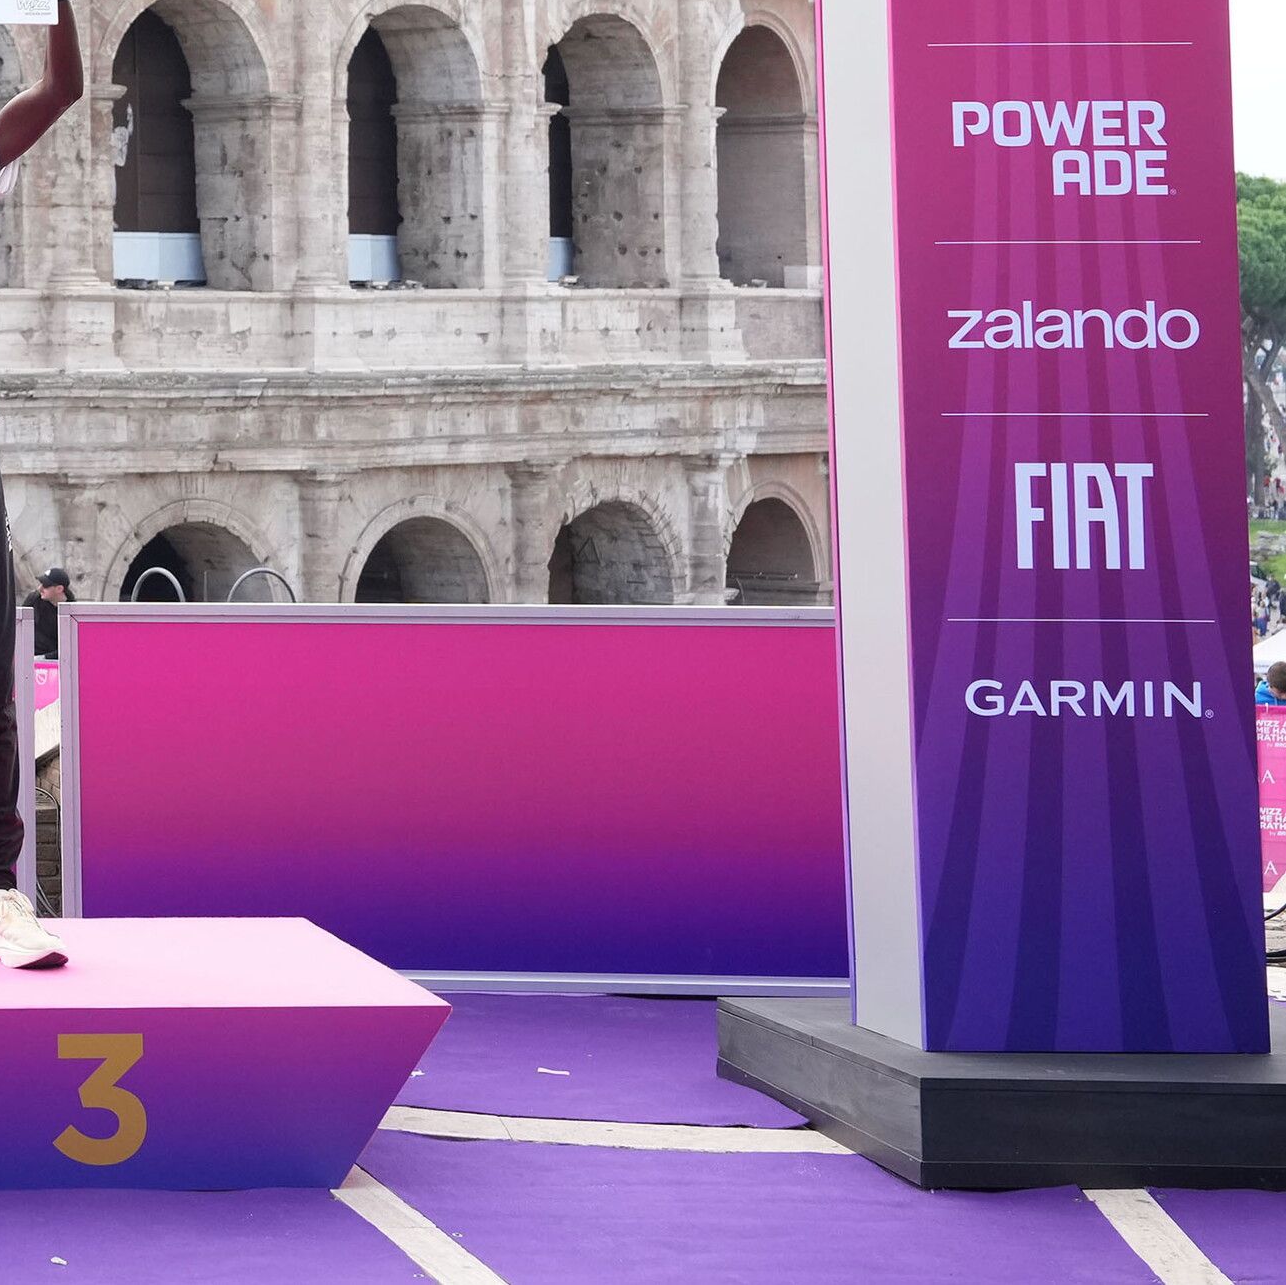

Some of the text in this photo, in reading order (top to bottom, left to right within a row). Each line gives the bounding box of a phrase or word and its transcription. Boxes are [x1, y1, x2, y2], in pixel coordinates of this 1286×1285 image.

[952, 101, 1167, 146] POWER
[948, 301, 1200, 350] zalando
[1014, 463, 1153, 569] FIAT
[52, 1033, 147, 1166] 3
